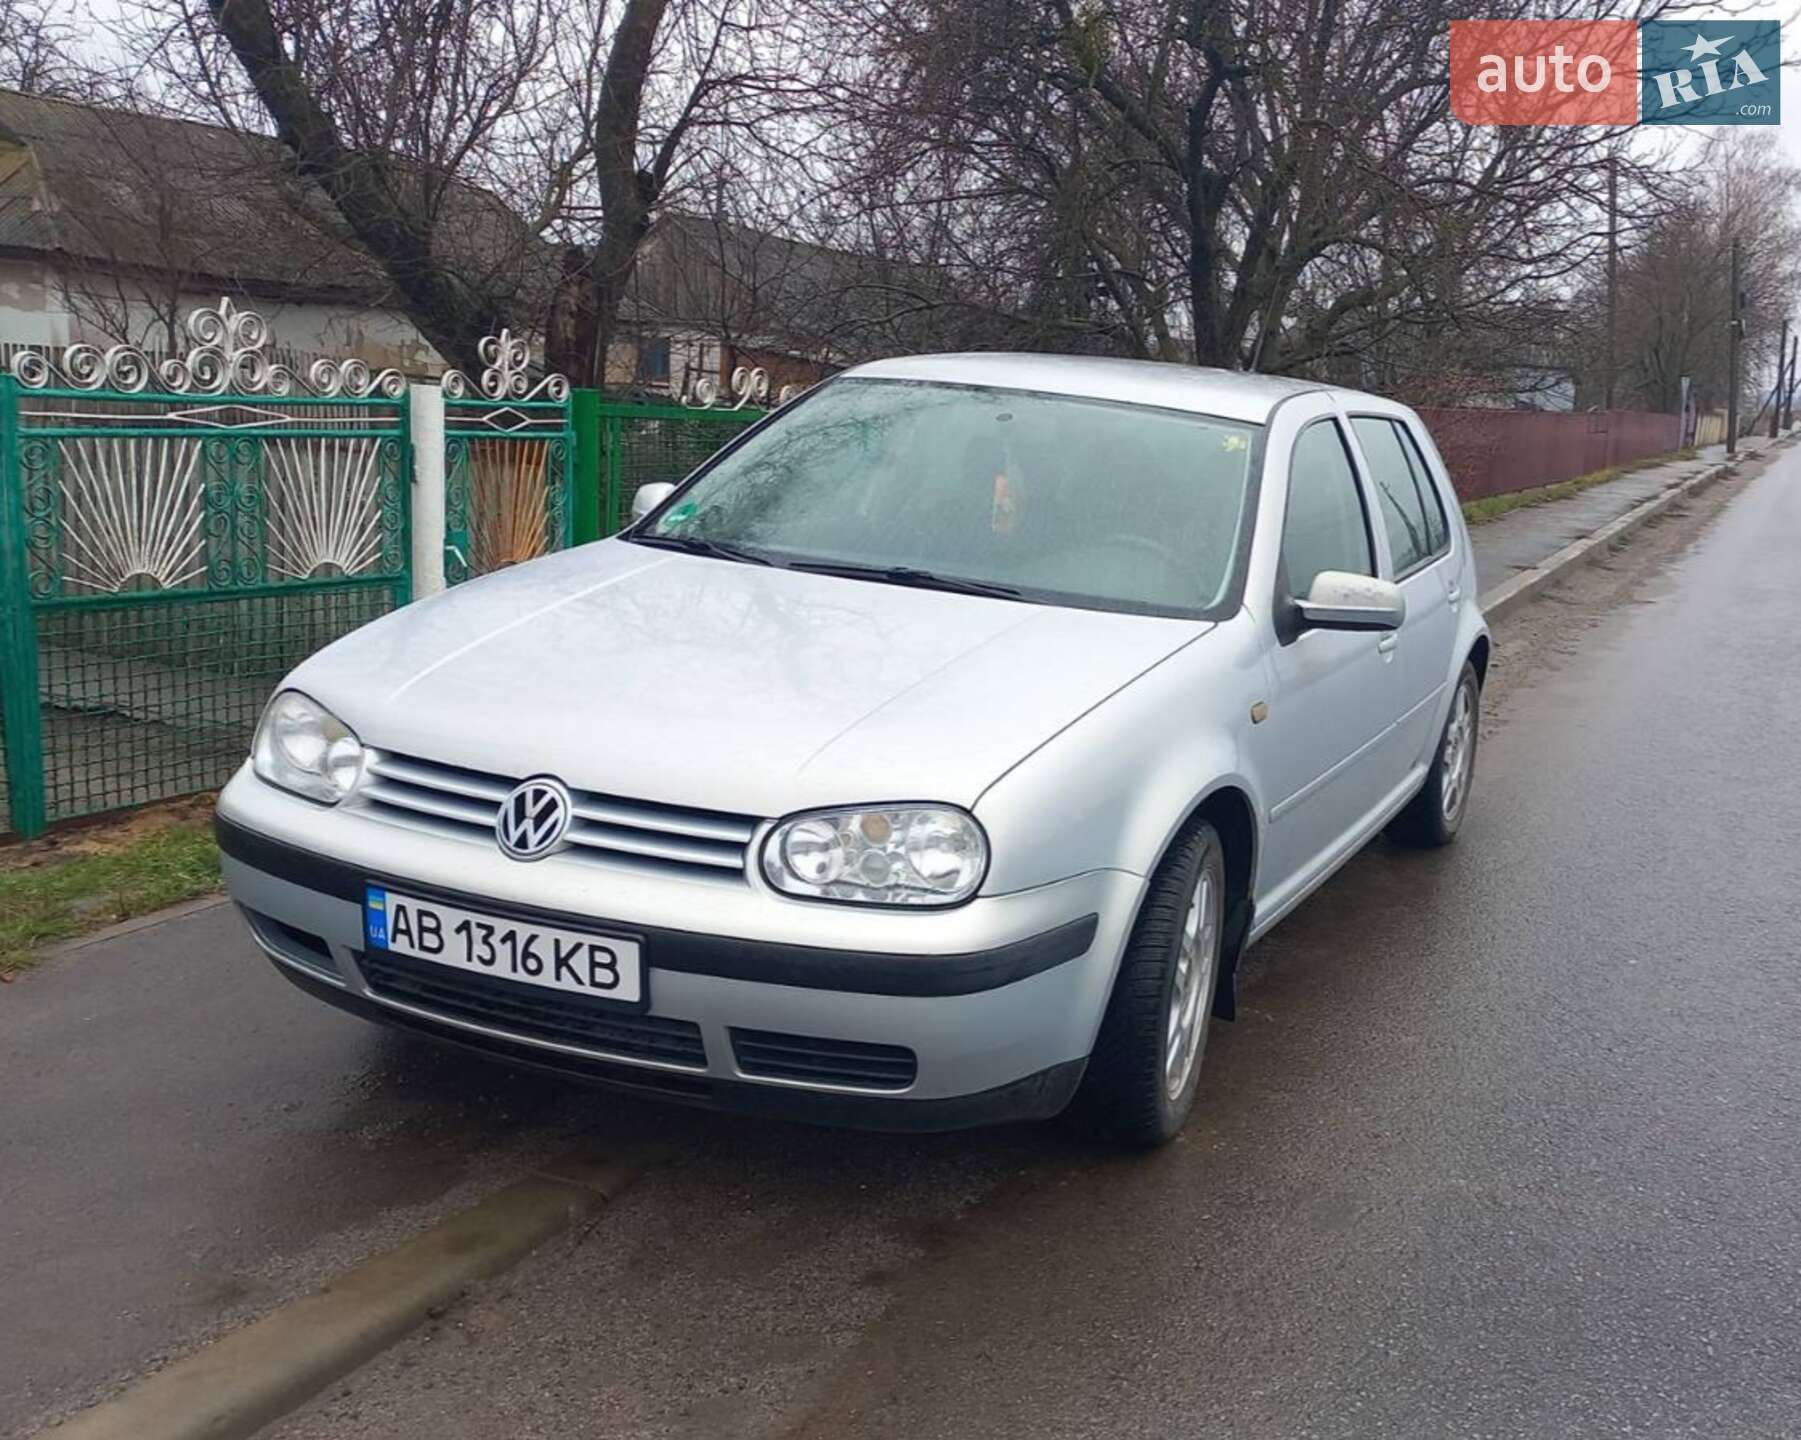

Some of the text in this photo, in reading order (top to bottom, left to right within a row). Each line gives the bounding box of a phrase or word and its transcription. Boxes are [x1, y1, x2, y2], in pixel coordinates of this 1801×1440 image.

[369, 925, 386, 940] UA
[391, 904, 620, 990] AB 1316 KB
